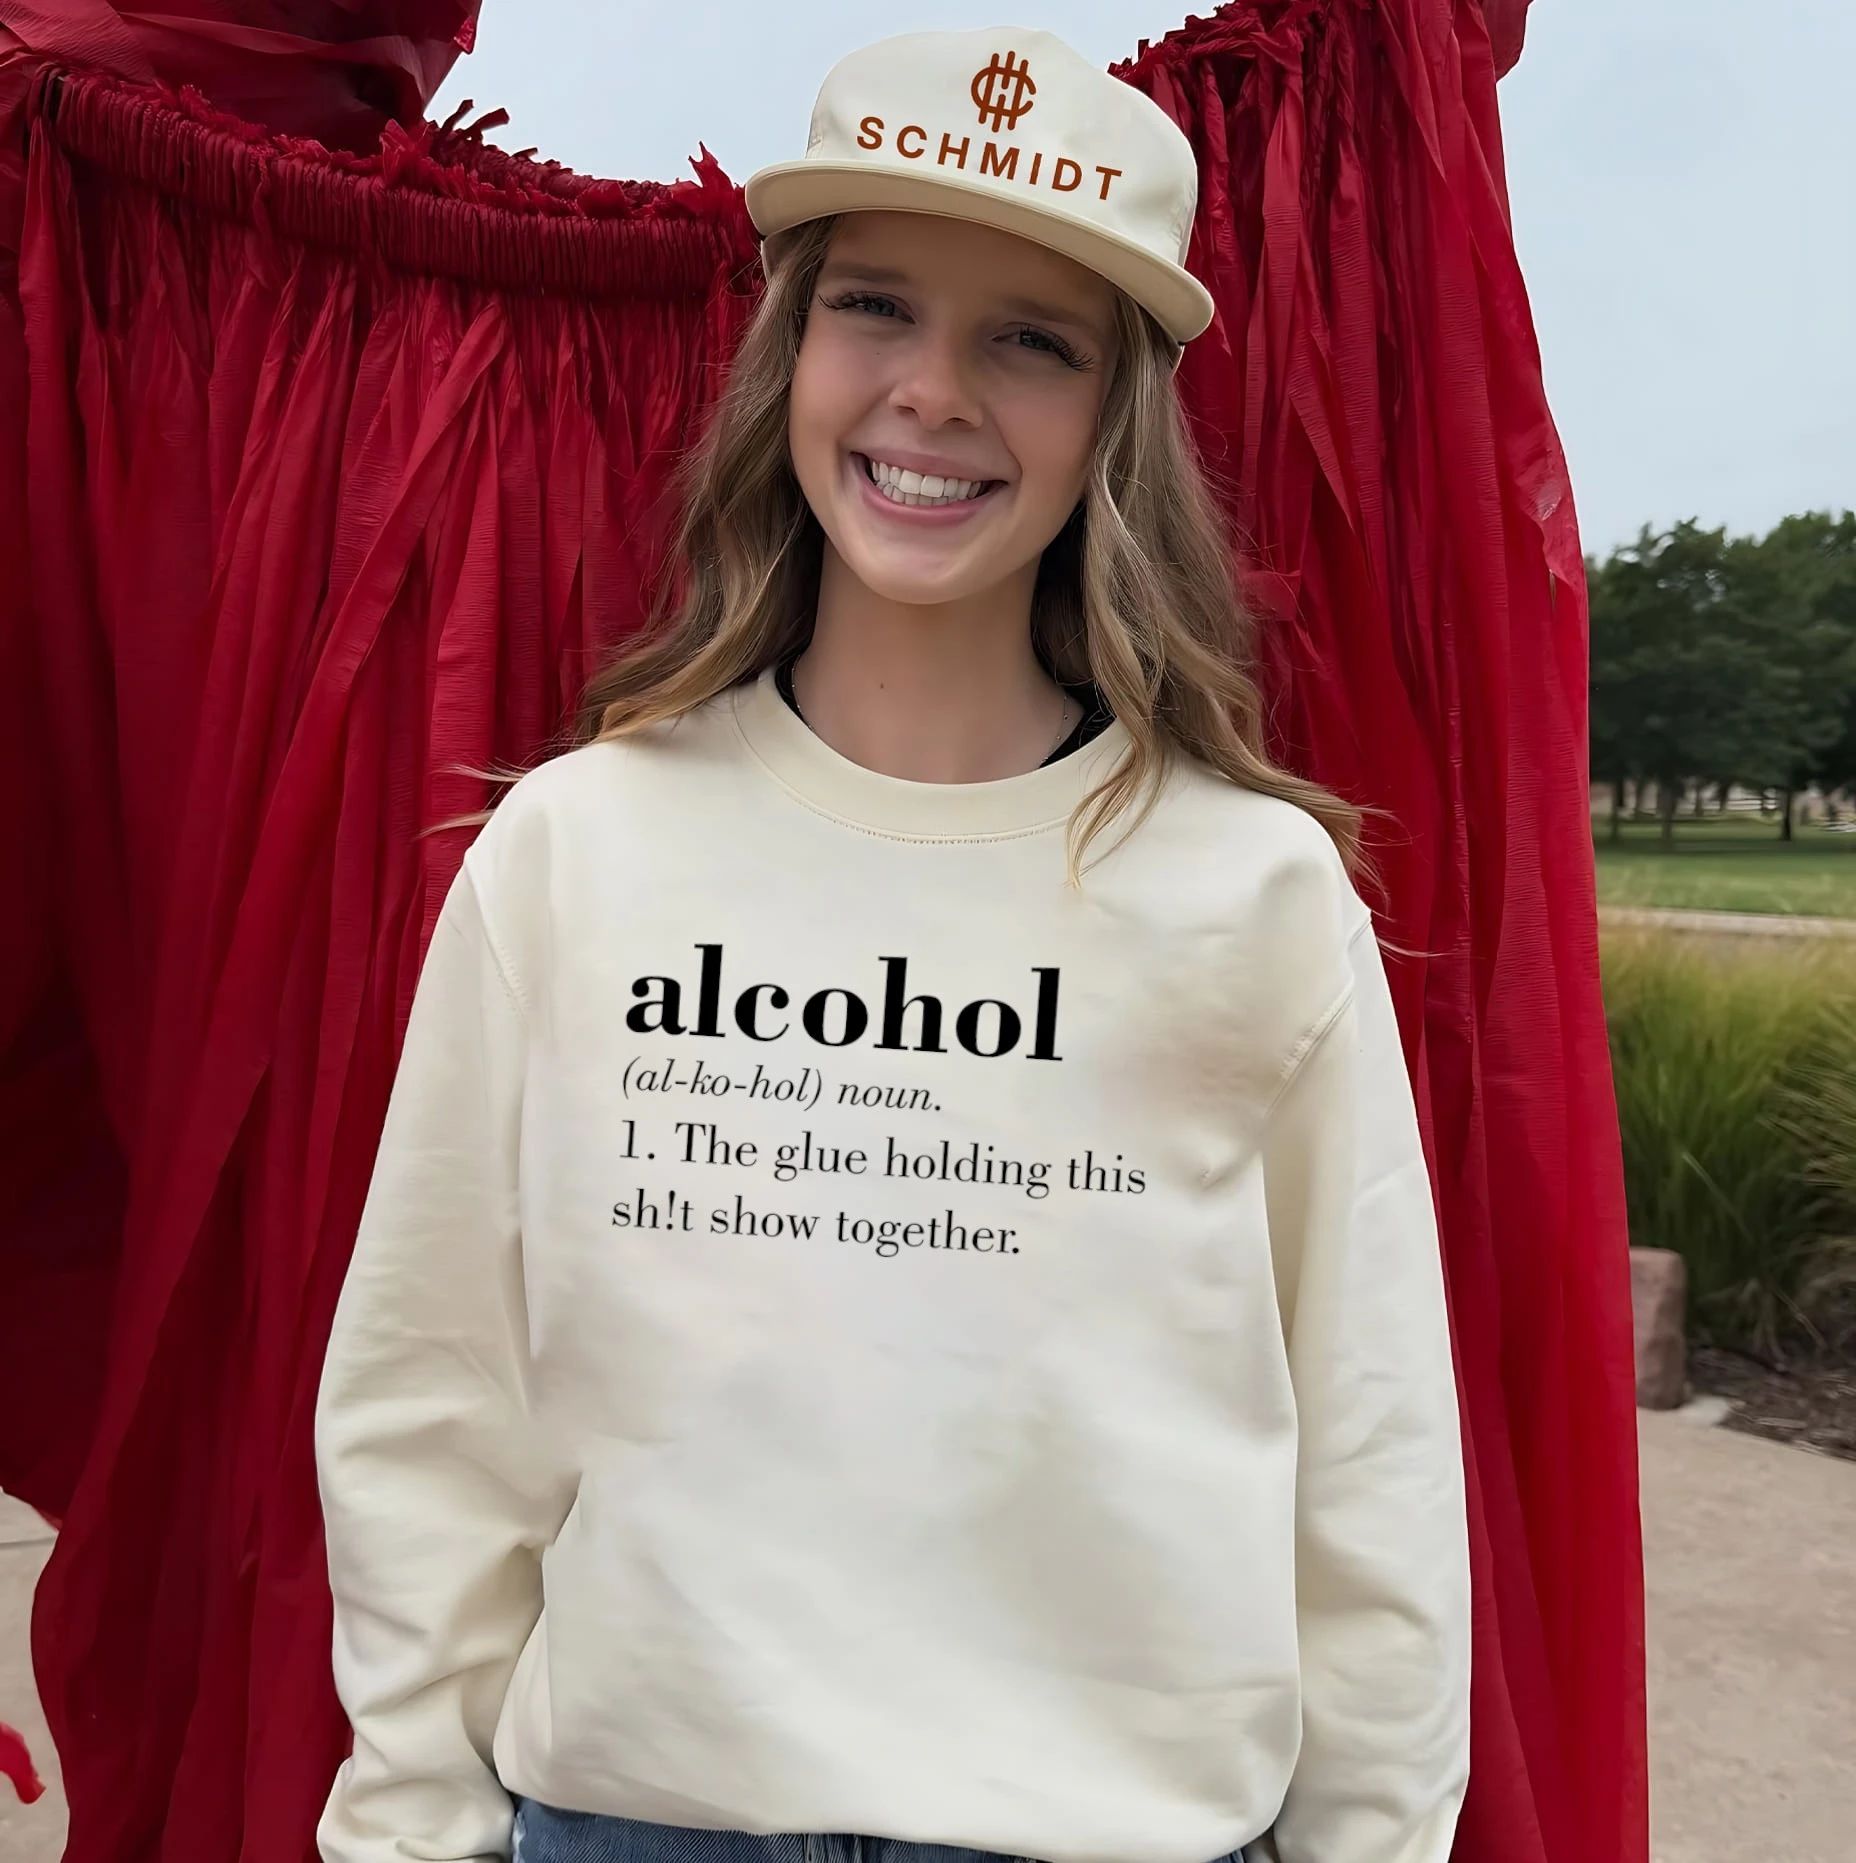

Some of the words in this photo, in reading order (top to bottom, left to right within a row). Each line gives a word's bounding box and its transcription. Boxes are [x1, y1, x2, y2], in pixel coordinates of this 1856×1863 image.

[857, 116, 1123, 200] SCHMIDT
[625, 943, 1063, 1062] alcohol
[622, 1056, 823, 1111] (al-ko-hol)
[837, 1080, 943, 1111] noun.
[619, 1120, 656, 1160] 1.
[675, 1122, 758, 1168] The
[774, 1131, 868, 1182] glue
[883, 1136, 1051, 1199] holding
[1067, 1151, 1147, 1195] this
[611, 1188, 694, 1232] sh!t
[709, 1196, 820, 1241] show
[836, 1210, 1021, 1258] together.
